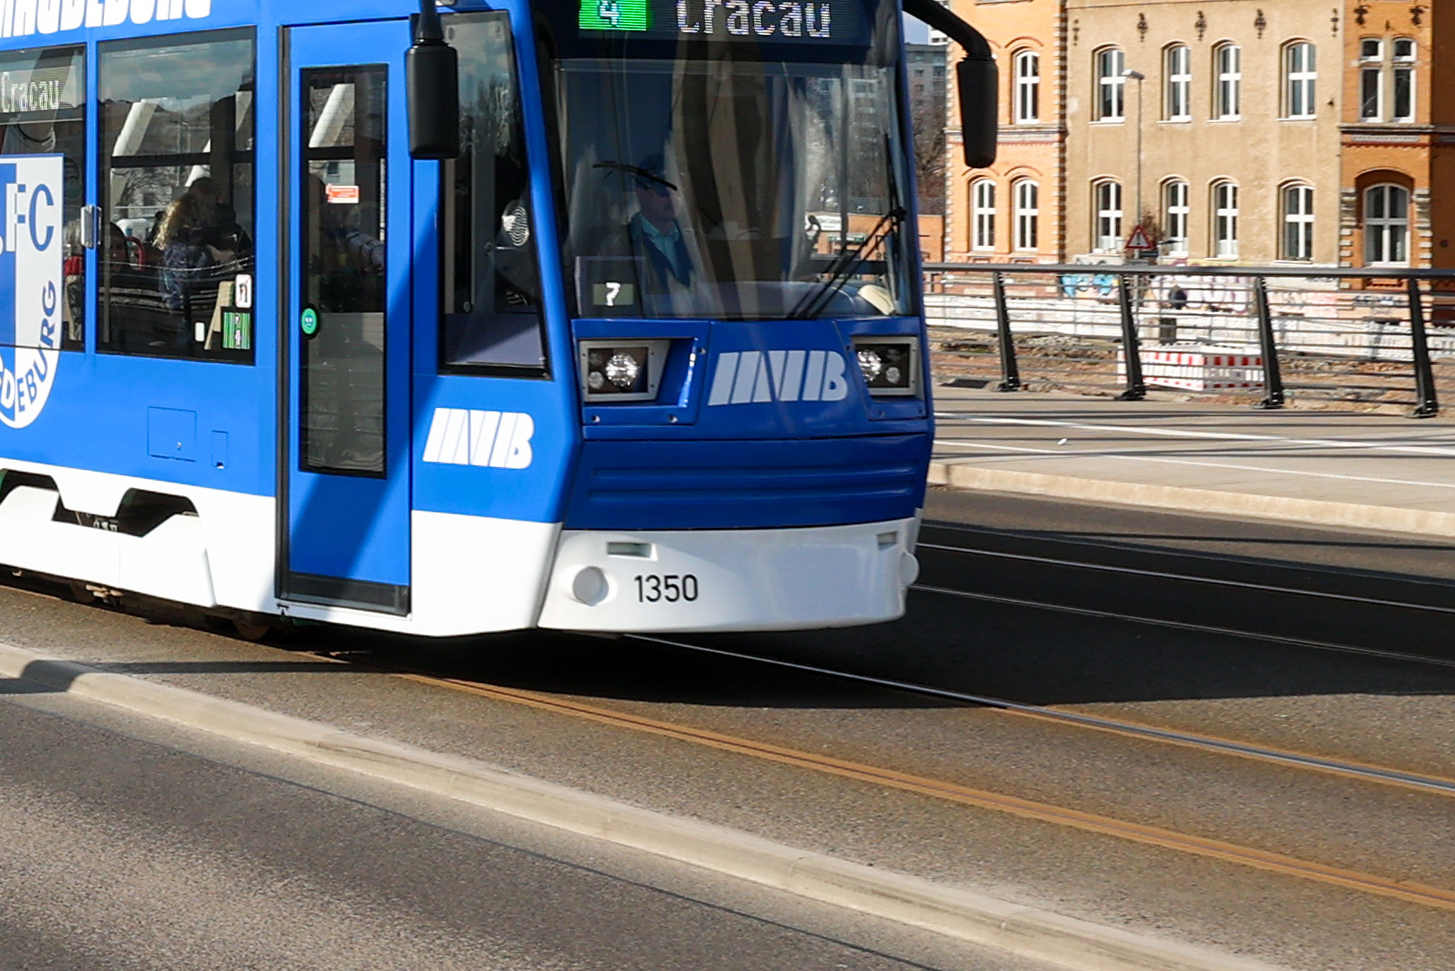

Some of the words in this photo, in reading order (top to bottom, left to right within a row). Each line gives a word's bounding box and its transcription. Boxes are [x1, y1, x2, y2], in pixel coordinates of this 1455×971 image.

[1, 71, 60, 113] Cracau
[605, 281, 621, 307] 7
[707, 350, 848, 406] MVB
[422, 407, 534, 470] MVB
[633, 573, 699, 603] 1350
